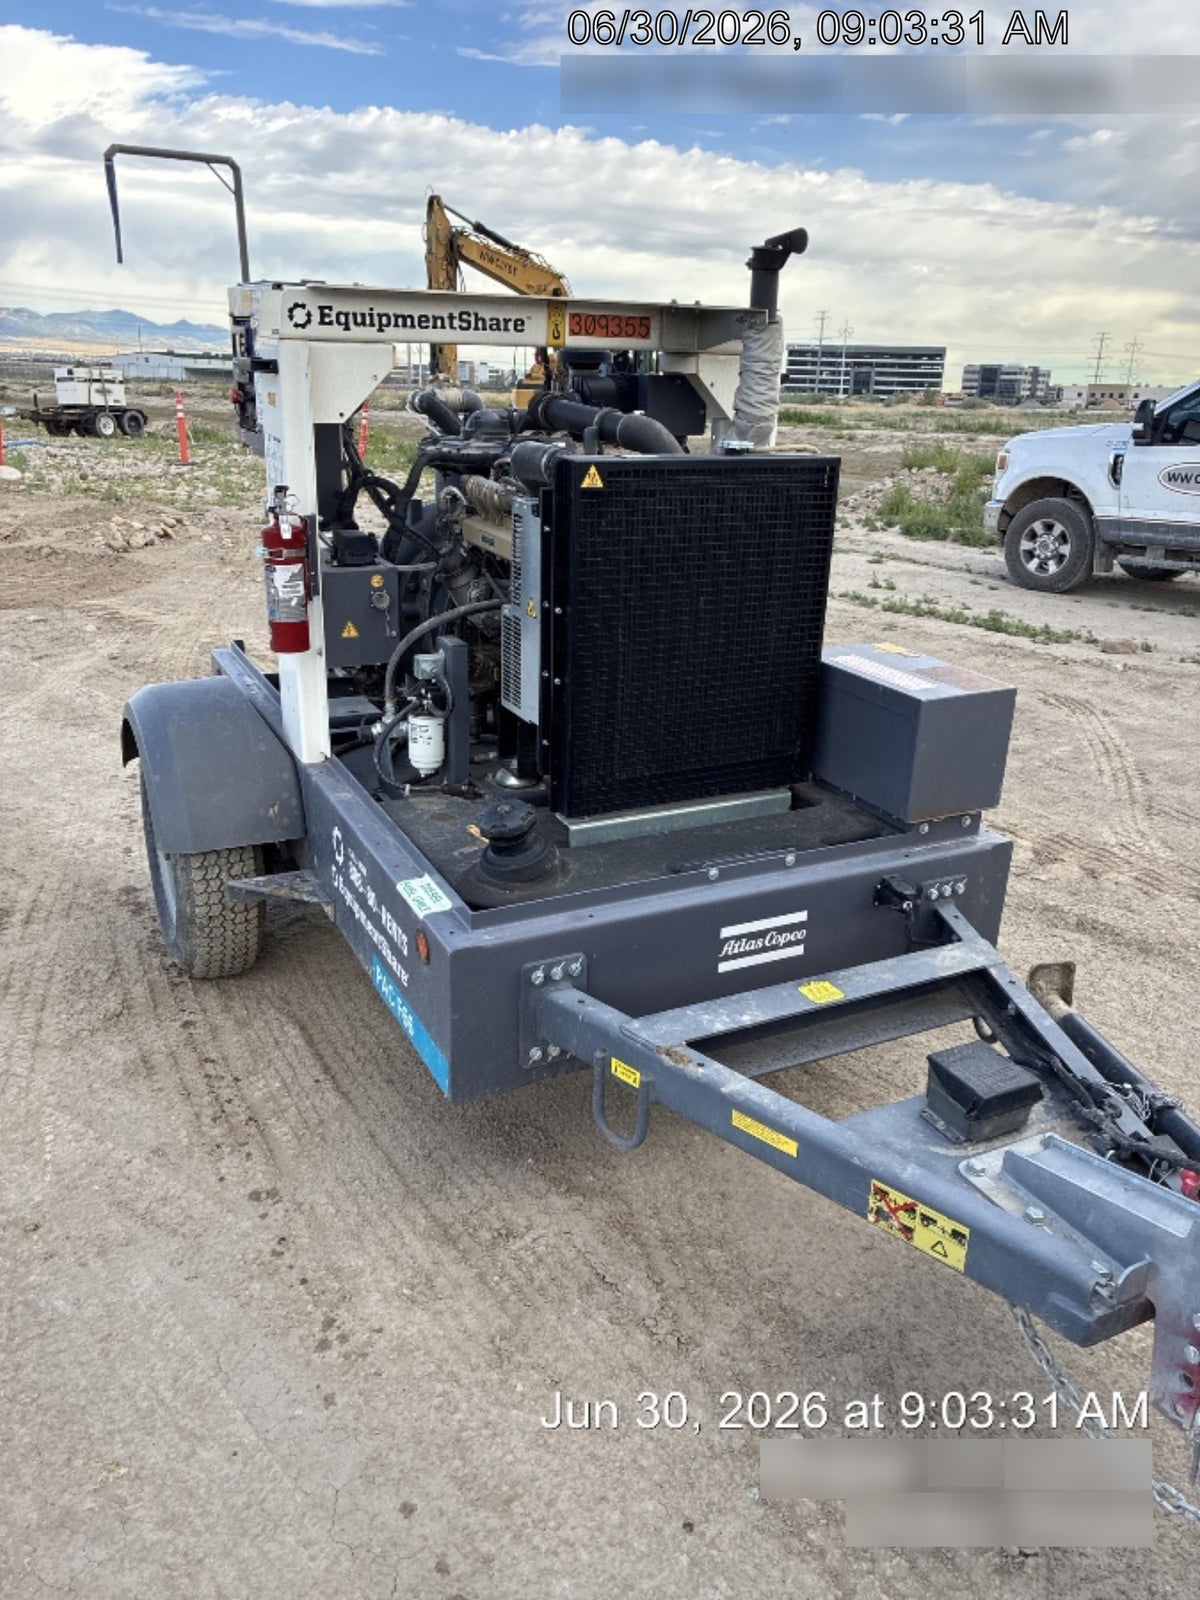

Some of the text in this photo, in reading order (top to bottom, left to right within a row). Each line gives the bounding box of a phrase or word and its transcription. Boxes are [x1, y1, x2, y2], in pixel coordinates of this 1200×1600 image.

[317, 305, 526, 334] EquipmentShare
[570, 313, 651, 339] 309355
[718, 928, 807, 958] Atlas Copco
